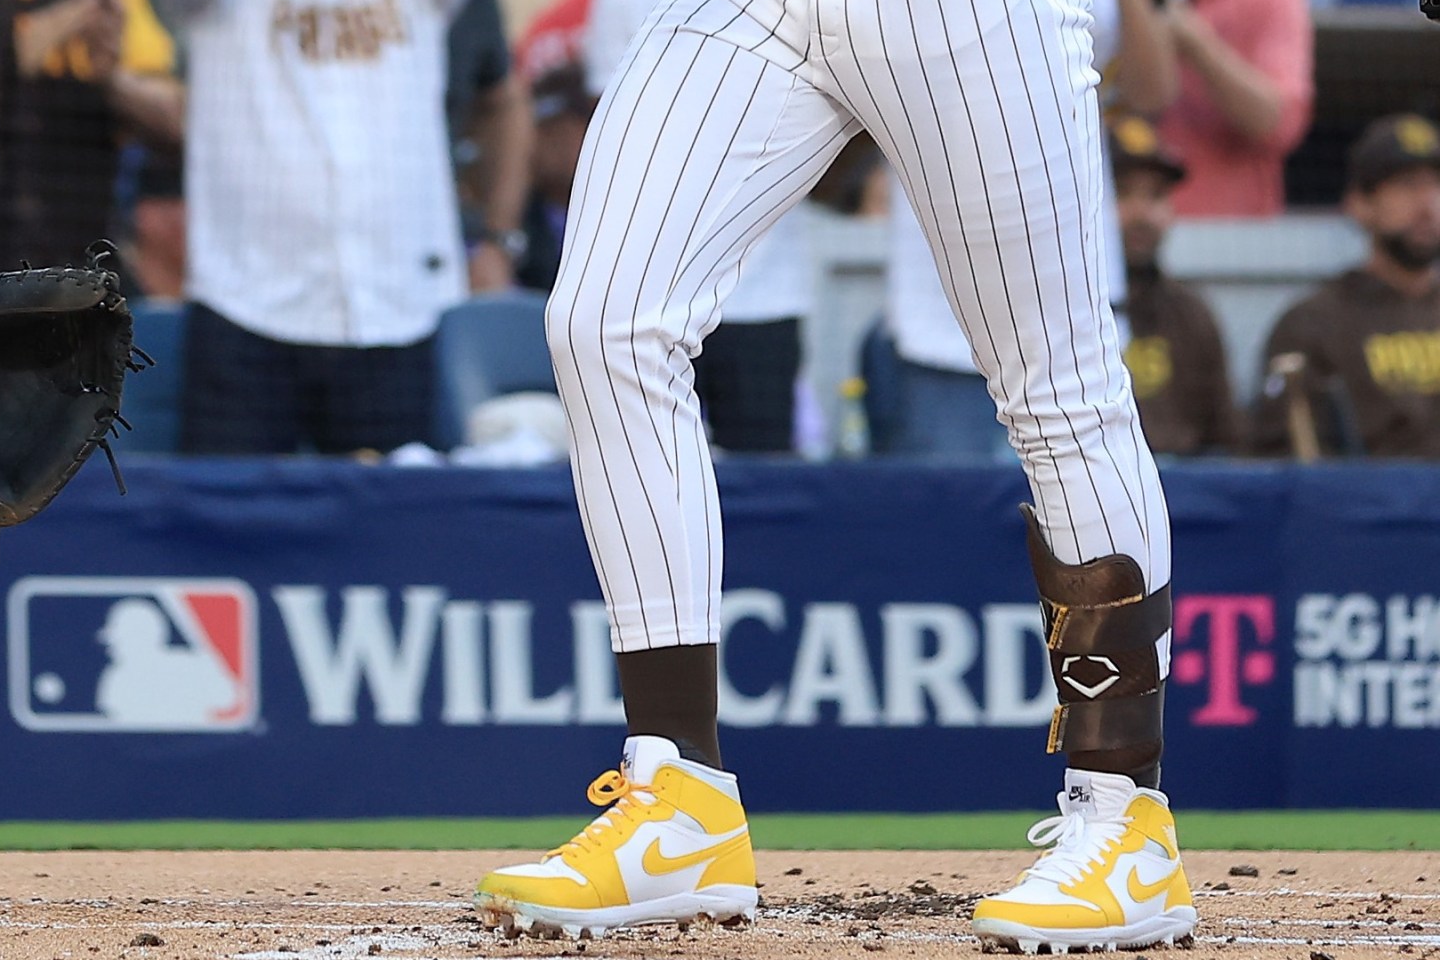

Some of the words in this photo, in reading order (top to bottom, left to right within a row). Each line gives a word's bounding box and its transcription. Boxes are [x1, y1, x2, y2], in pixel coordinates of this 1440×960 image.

[717, 588, 1060, 728] CARD
[1294, 593, 1381, 662] 5G
[1385, 595, 1440, 662] H
[1293, 660, 1440, 728] INTE
